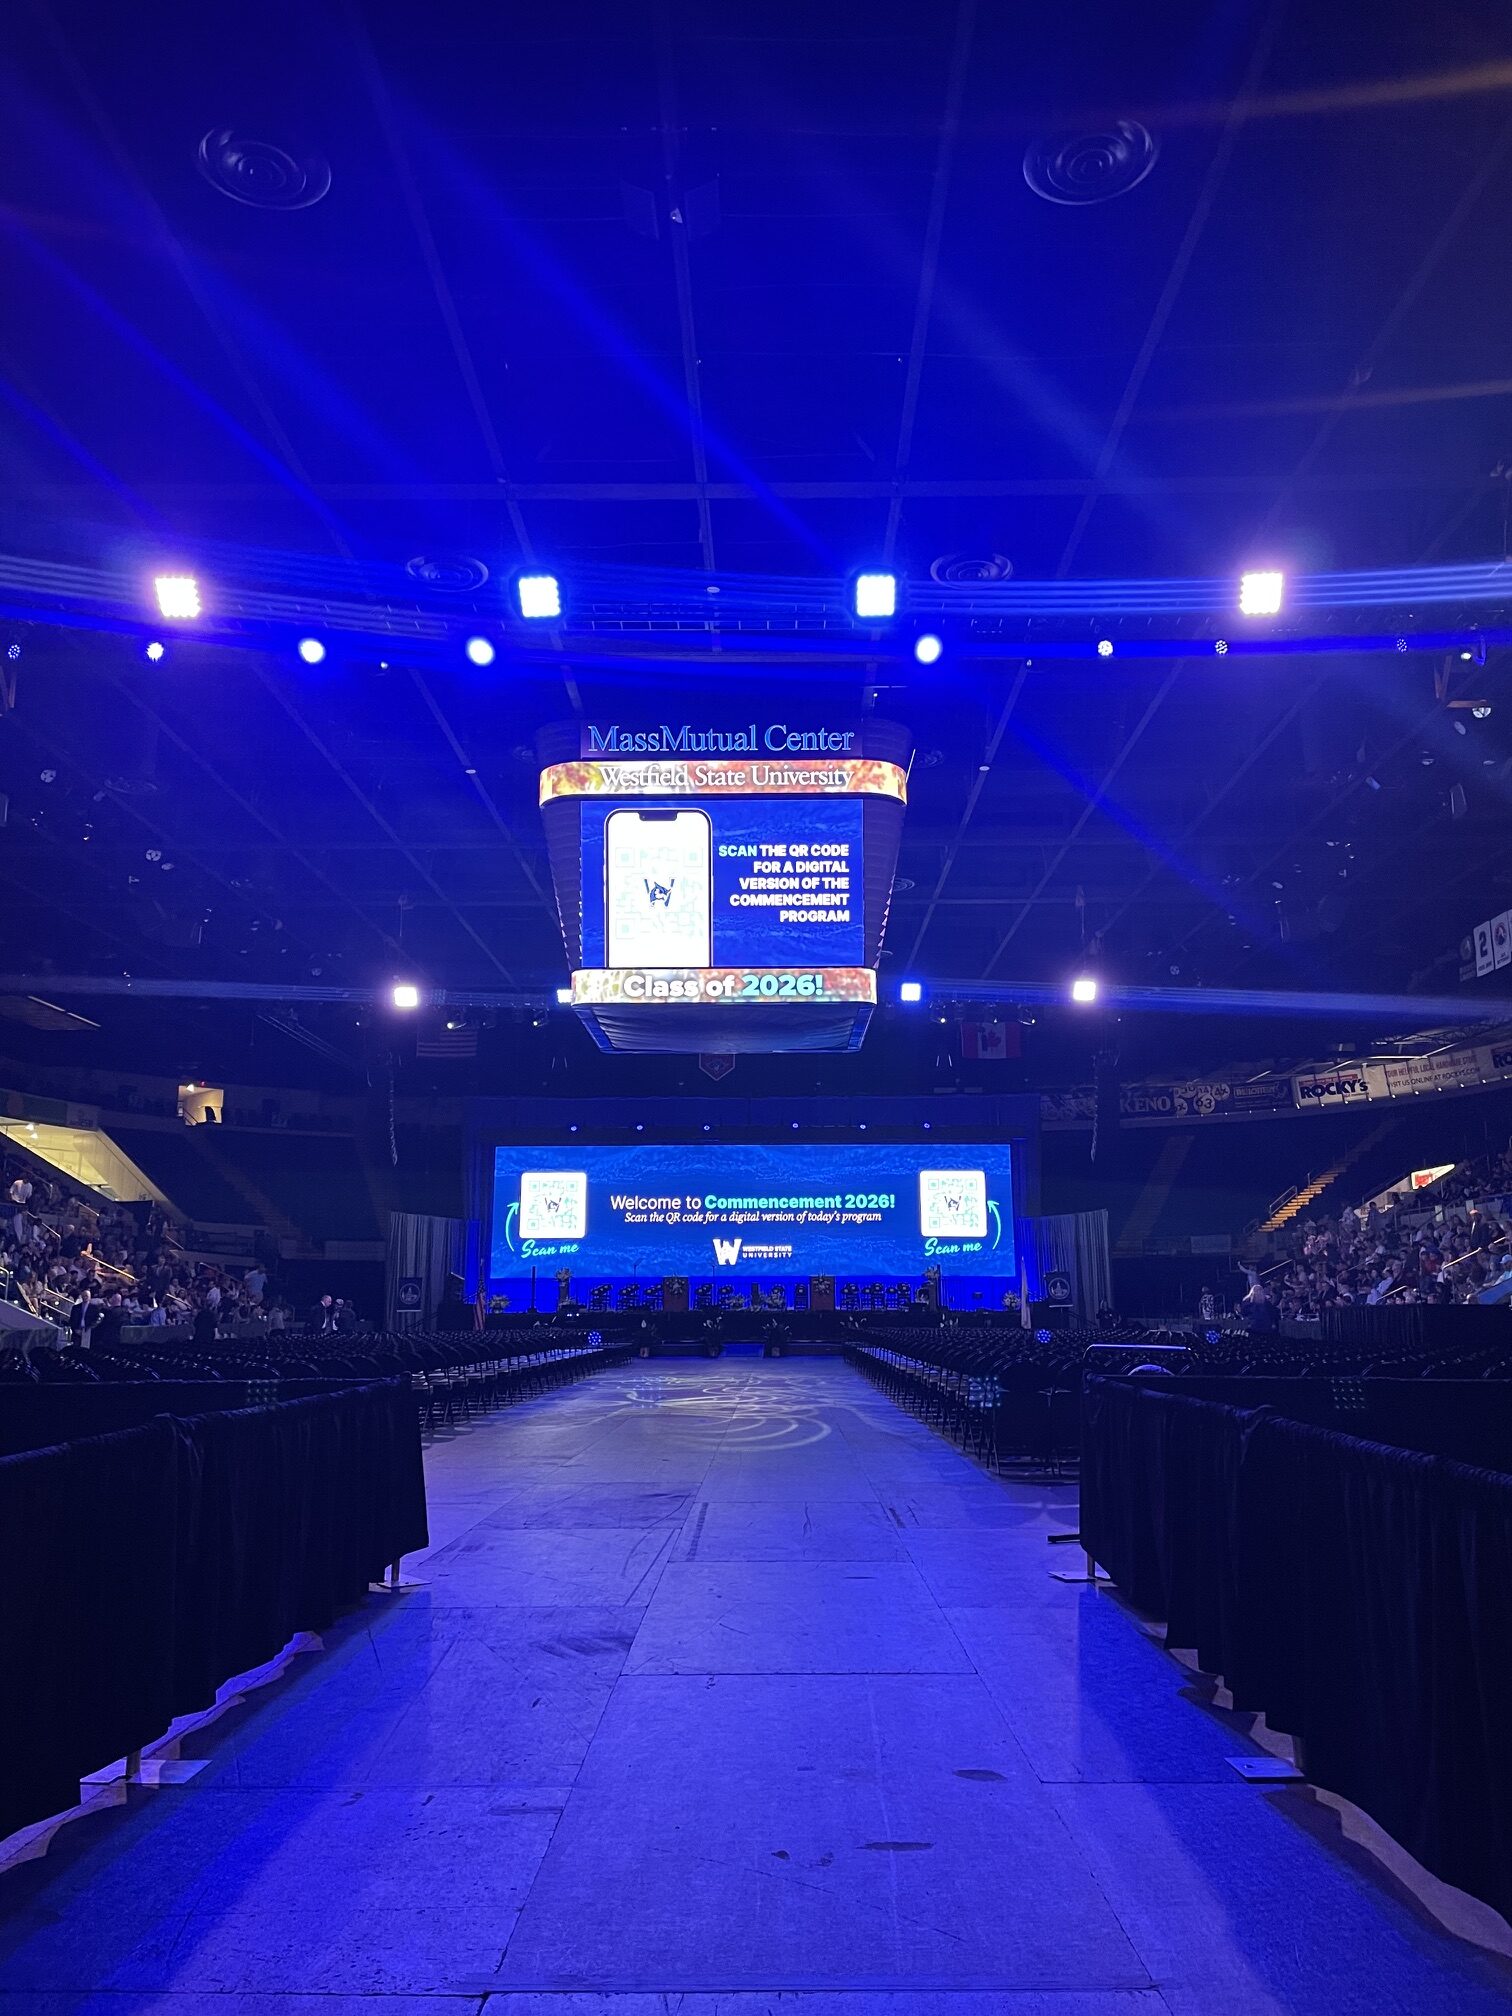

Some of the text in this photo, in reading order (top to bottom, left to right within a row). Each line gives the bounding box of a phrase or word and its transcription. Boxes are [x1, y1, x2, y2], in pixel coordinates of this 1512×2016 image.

[588, 724, 855, 752] MassMutual Center
[599, 763, 854, 788] Westfield State University
[719, 844, 850, 858] SCAN THE QR CODE
[753, 860, 850, 873] FOR A DIGITAL
[739, 877, 850, 890] VERSION OF THE
[729, 893, 850, 907] COMMENCEMENT
[779, 910, 850, 923] PROGRAM
[1479, 931, 1488, 957] 2
[623, 974, 823, 997] Class of 2026!
[1120, 1095, 1172, 1113] KENO
[610, 1193, 896, 1209] Welcome to Commencement 2026!
[624, 1210, 882, 1225] Scan the QR code for a digital version of today's program
[521, 1239, 579, 1258] Scan me
[924, 1237, 982, 1256] Scan me
